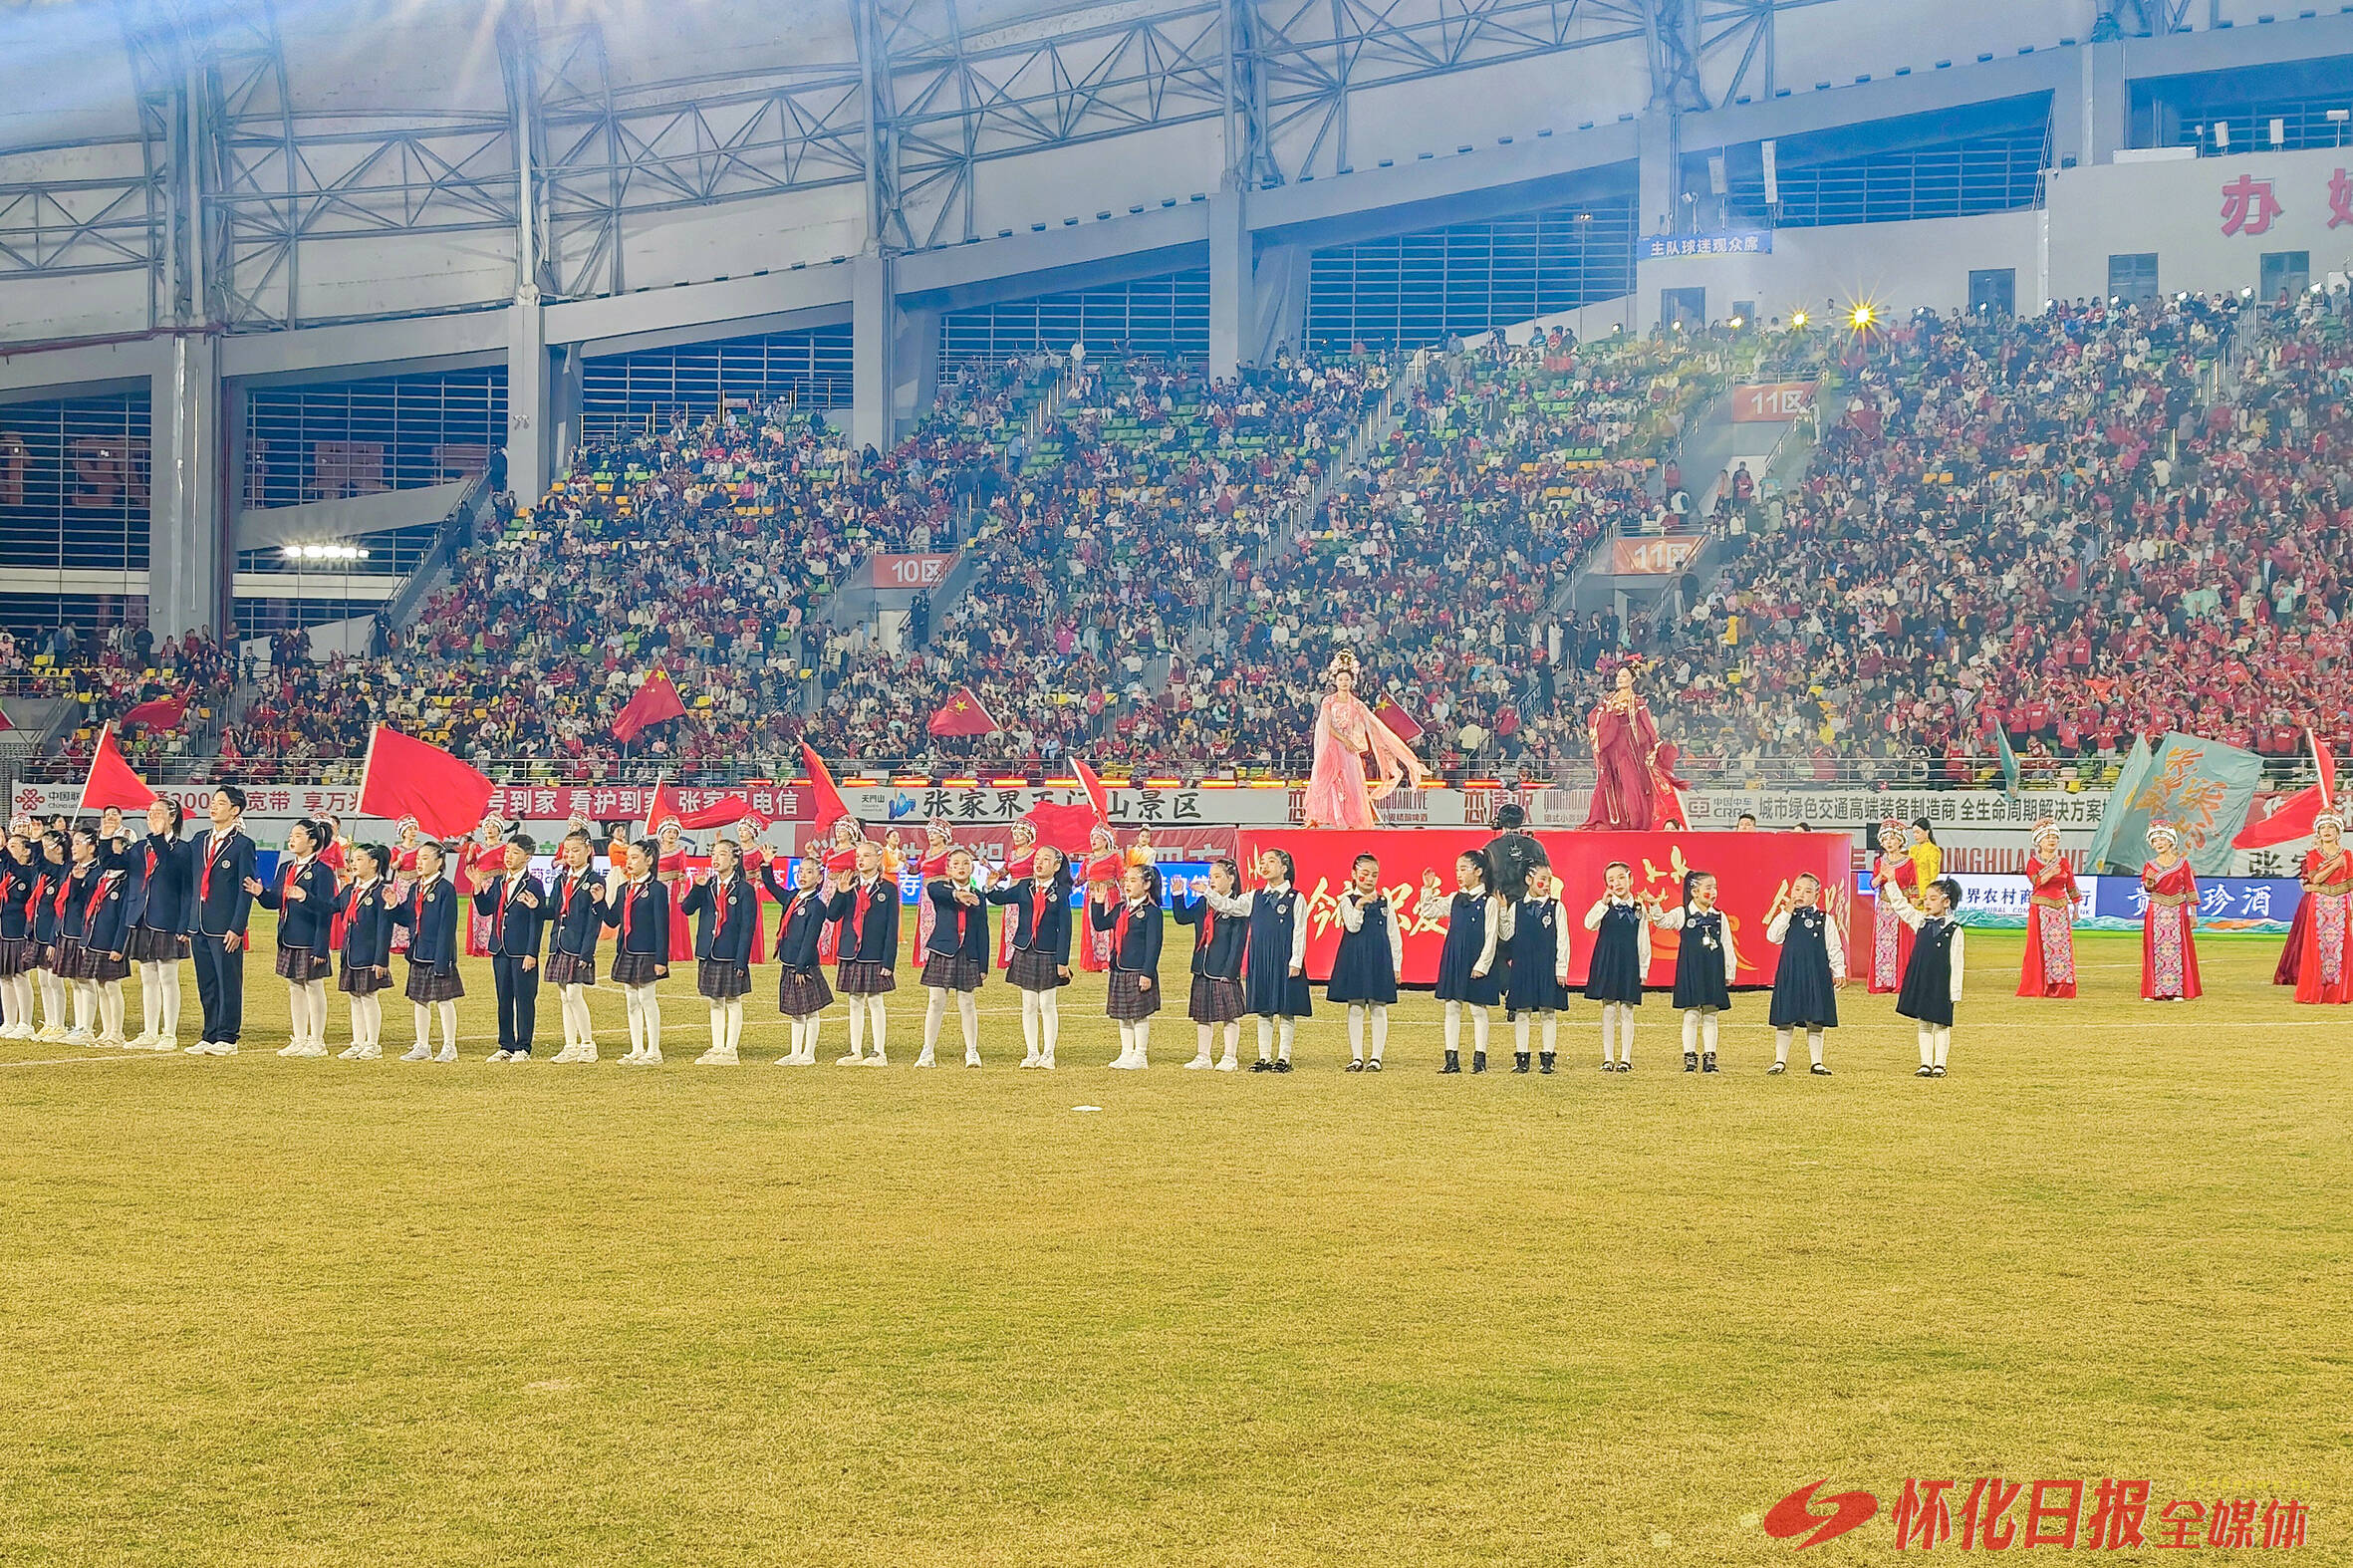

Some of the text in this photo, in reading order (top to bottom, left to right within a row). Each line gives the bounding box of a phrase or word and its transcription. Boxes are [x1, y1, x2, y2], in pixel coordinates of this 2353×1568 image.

[1650, 235, 1759, 256] 主队球迷观众席
[1751, 390, 1804, 414] 11区
[1635, 543, 1691, 570] 11区
[892, 559, 944, 583] 10区
[48, 791, 81, 801] 中国联
[1713, 797, 1752, 806] 中国中车
[1759, 797, 2108, 822] 城市绿色交通高端装备制造商 全生命周期解决方案
